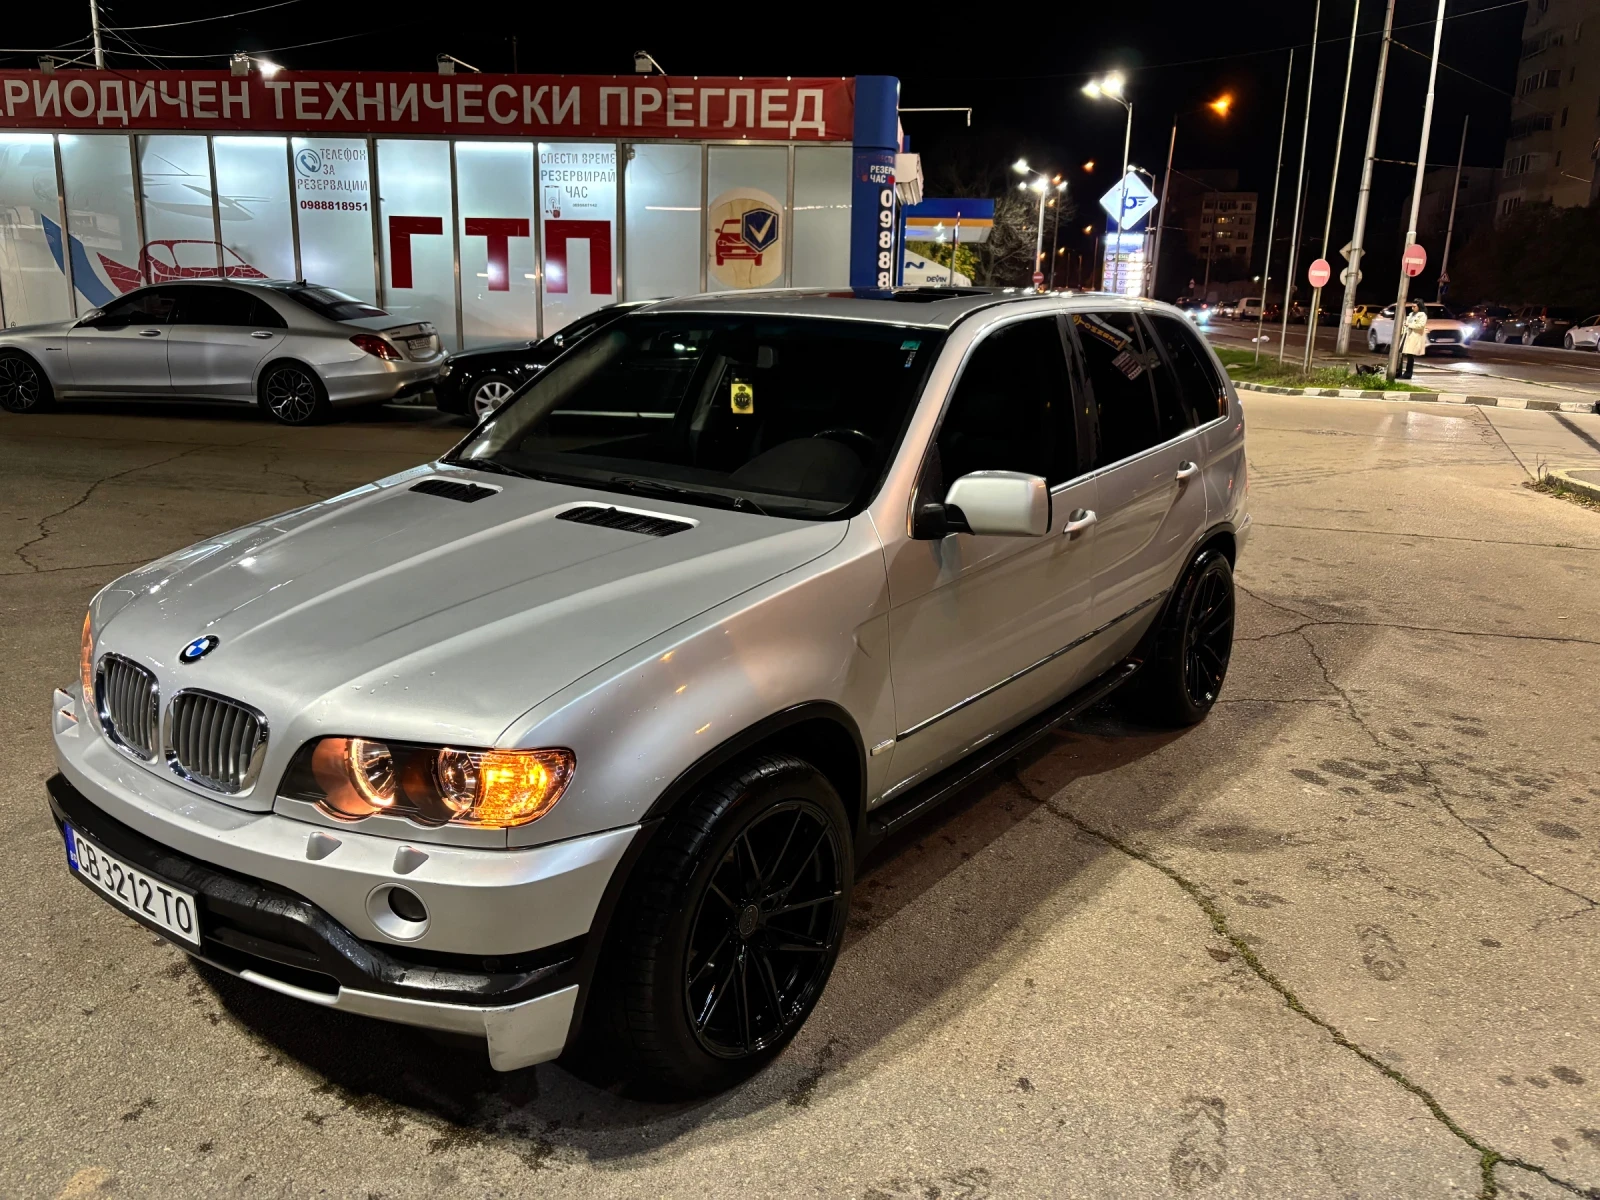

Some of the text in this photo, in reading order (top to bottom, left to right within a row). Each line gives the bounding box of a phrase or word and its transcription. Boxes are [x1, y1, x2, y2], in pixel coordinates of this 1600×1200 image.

[0, 80, 825, 137] РИОДИЧЕН ТЕХНИЧЕСКИ ПРЕГЛЕД
[320, 148, 366, 162] ТЕЛЕФОН
[541, 153, 615, 164] СПЕСТИ ВРЕМЕ
[323, 164, 336, 175] ЗА
[541, 169, 616, 182] РЕЗЕРВИРАЙ
[870, 174, 887, 184] ЧАС
[297, 178, 368, 193] РЕЗЕРВАЦИИ
[565, 185, 588, 198] ЧАС
[300, 200, 368, 211] 0988818951
[926, 275, 947, 283] DEVIN
